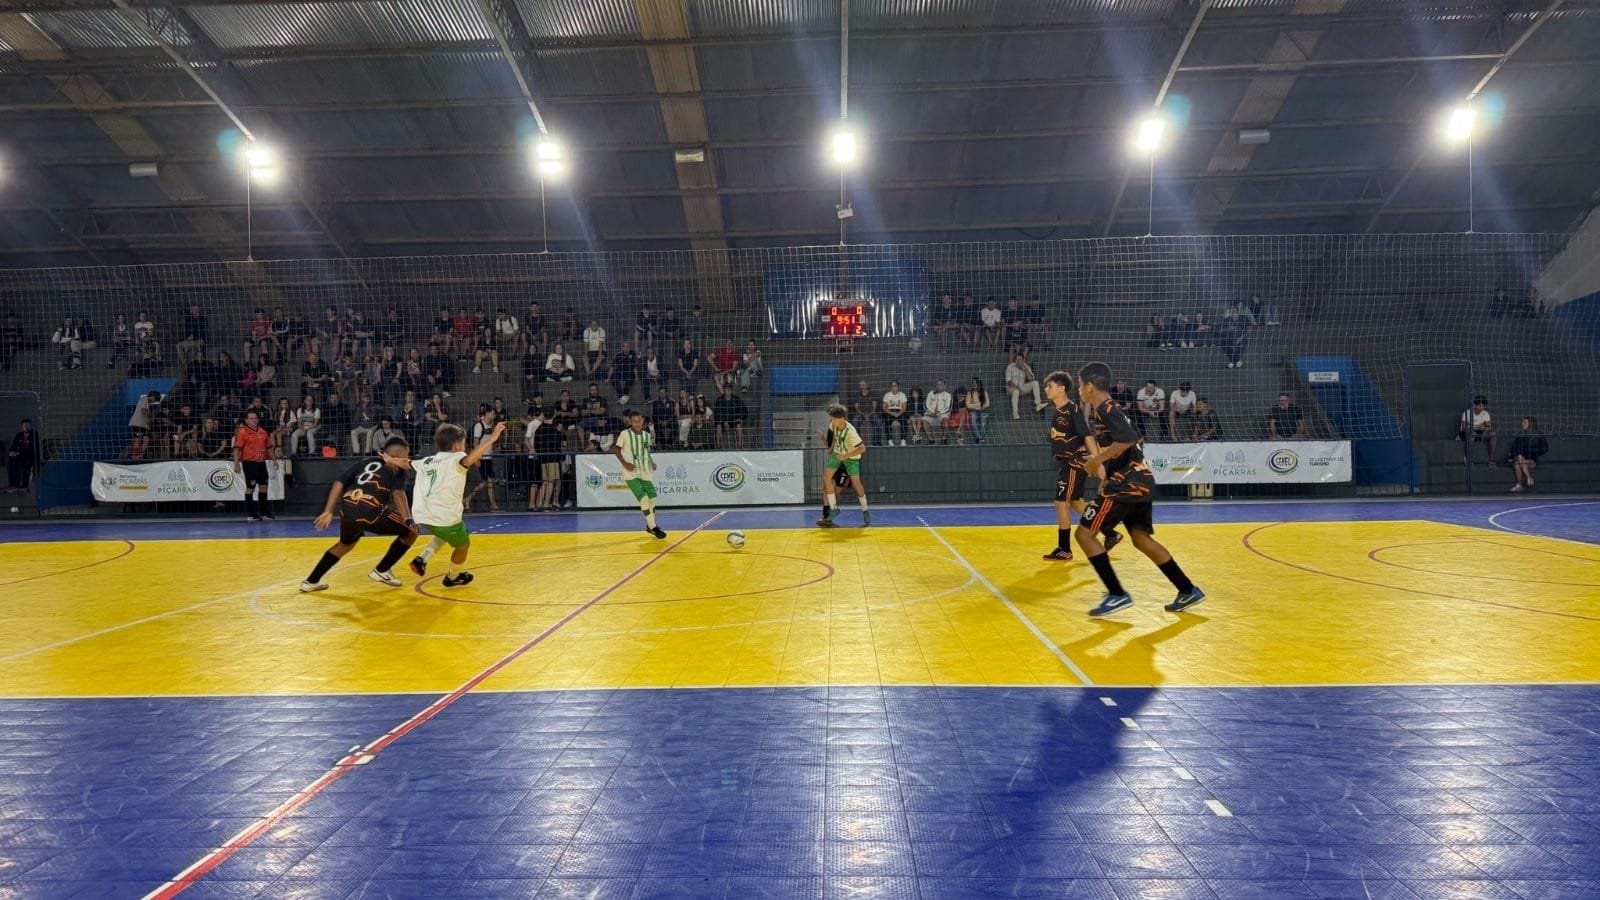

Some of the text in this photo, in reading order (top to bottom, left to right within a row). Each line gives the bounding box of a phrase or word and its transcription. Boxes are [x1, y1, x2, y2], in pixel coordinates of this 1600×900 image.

[837, 316, 855, 324] 9:51
[357, 461, 382, 485] 8
[1214, 469, 1257, 477] PIÇARRAS
[426, 469, 437, 497] 7
[1058, 486, 1065, 496] 7
